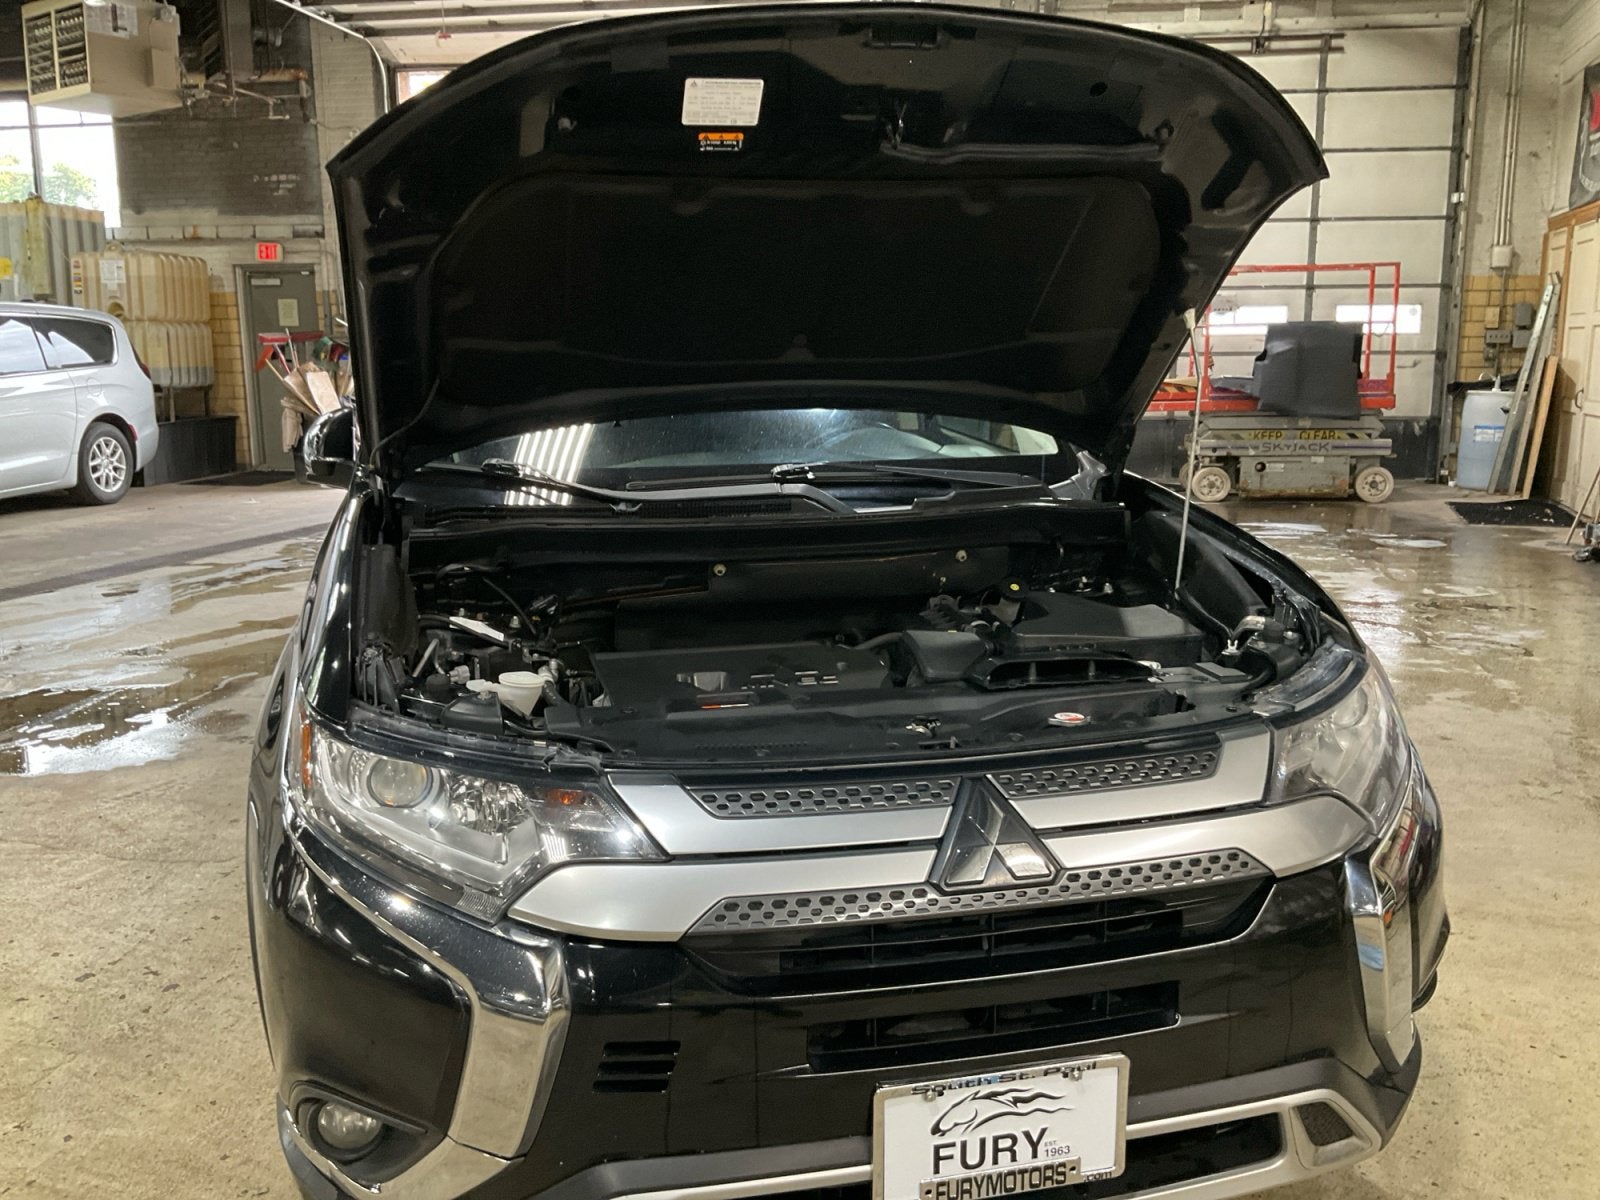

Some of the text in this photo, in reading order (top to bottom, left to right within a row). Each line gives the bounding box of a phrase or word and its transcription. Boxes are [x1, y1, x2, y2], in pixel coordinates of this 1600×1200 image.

[258, 243, 278, 260] EXIT
[1253, 430, 1336, 440] KEEP CLEAR
[1261, 442, 1330, 452] SKYJACK
[911, 1061, 1097, 1097] South St. Paul
[932, 1127, 1049, 1175] FURY
[1044, 1145, 1071, 1158] 1963
[935, 1162, 1112, 1200] FURYMOTORS .com
